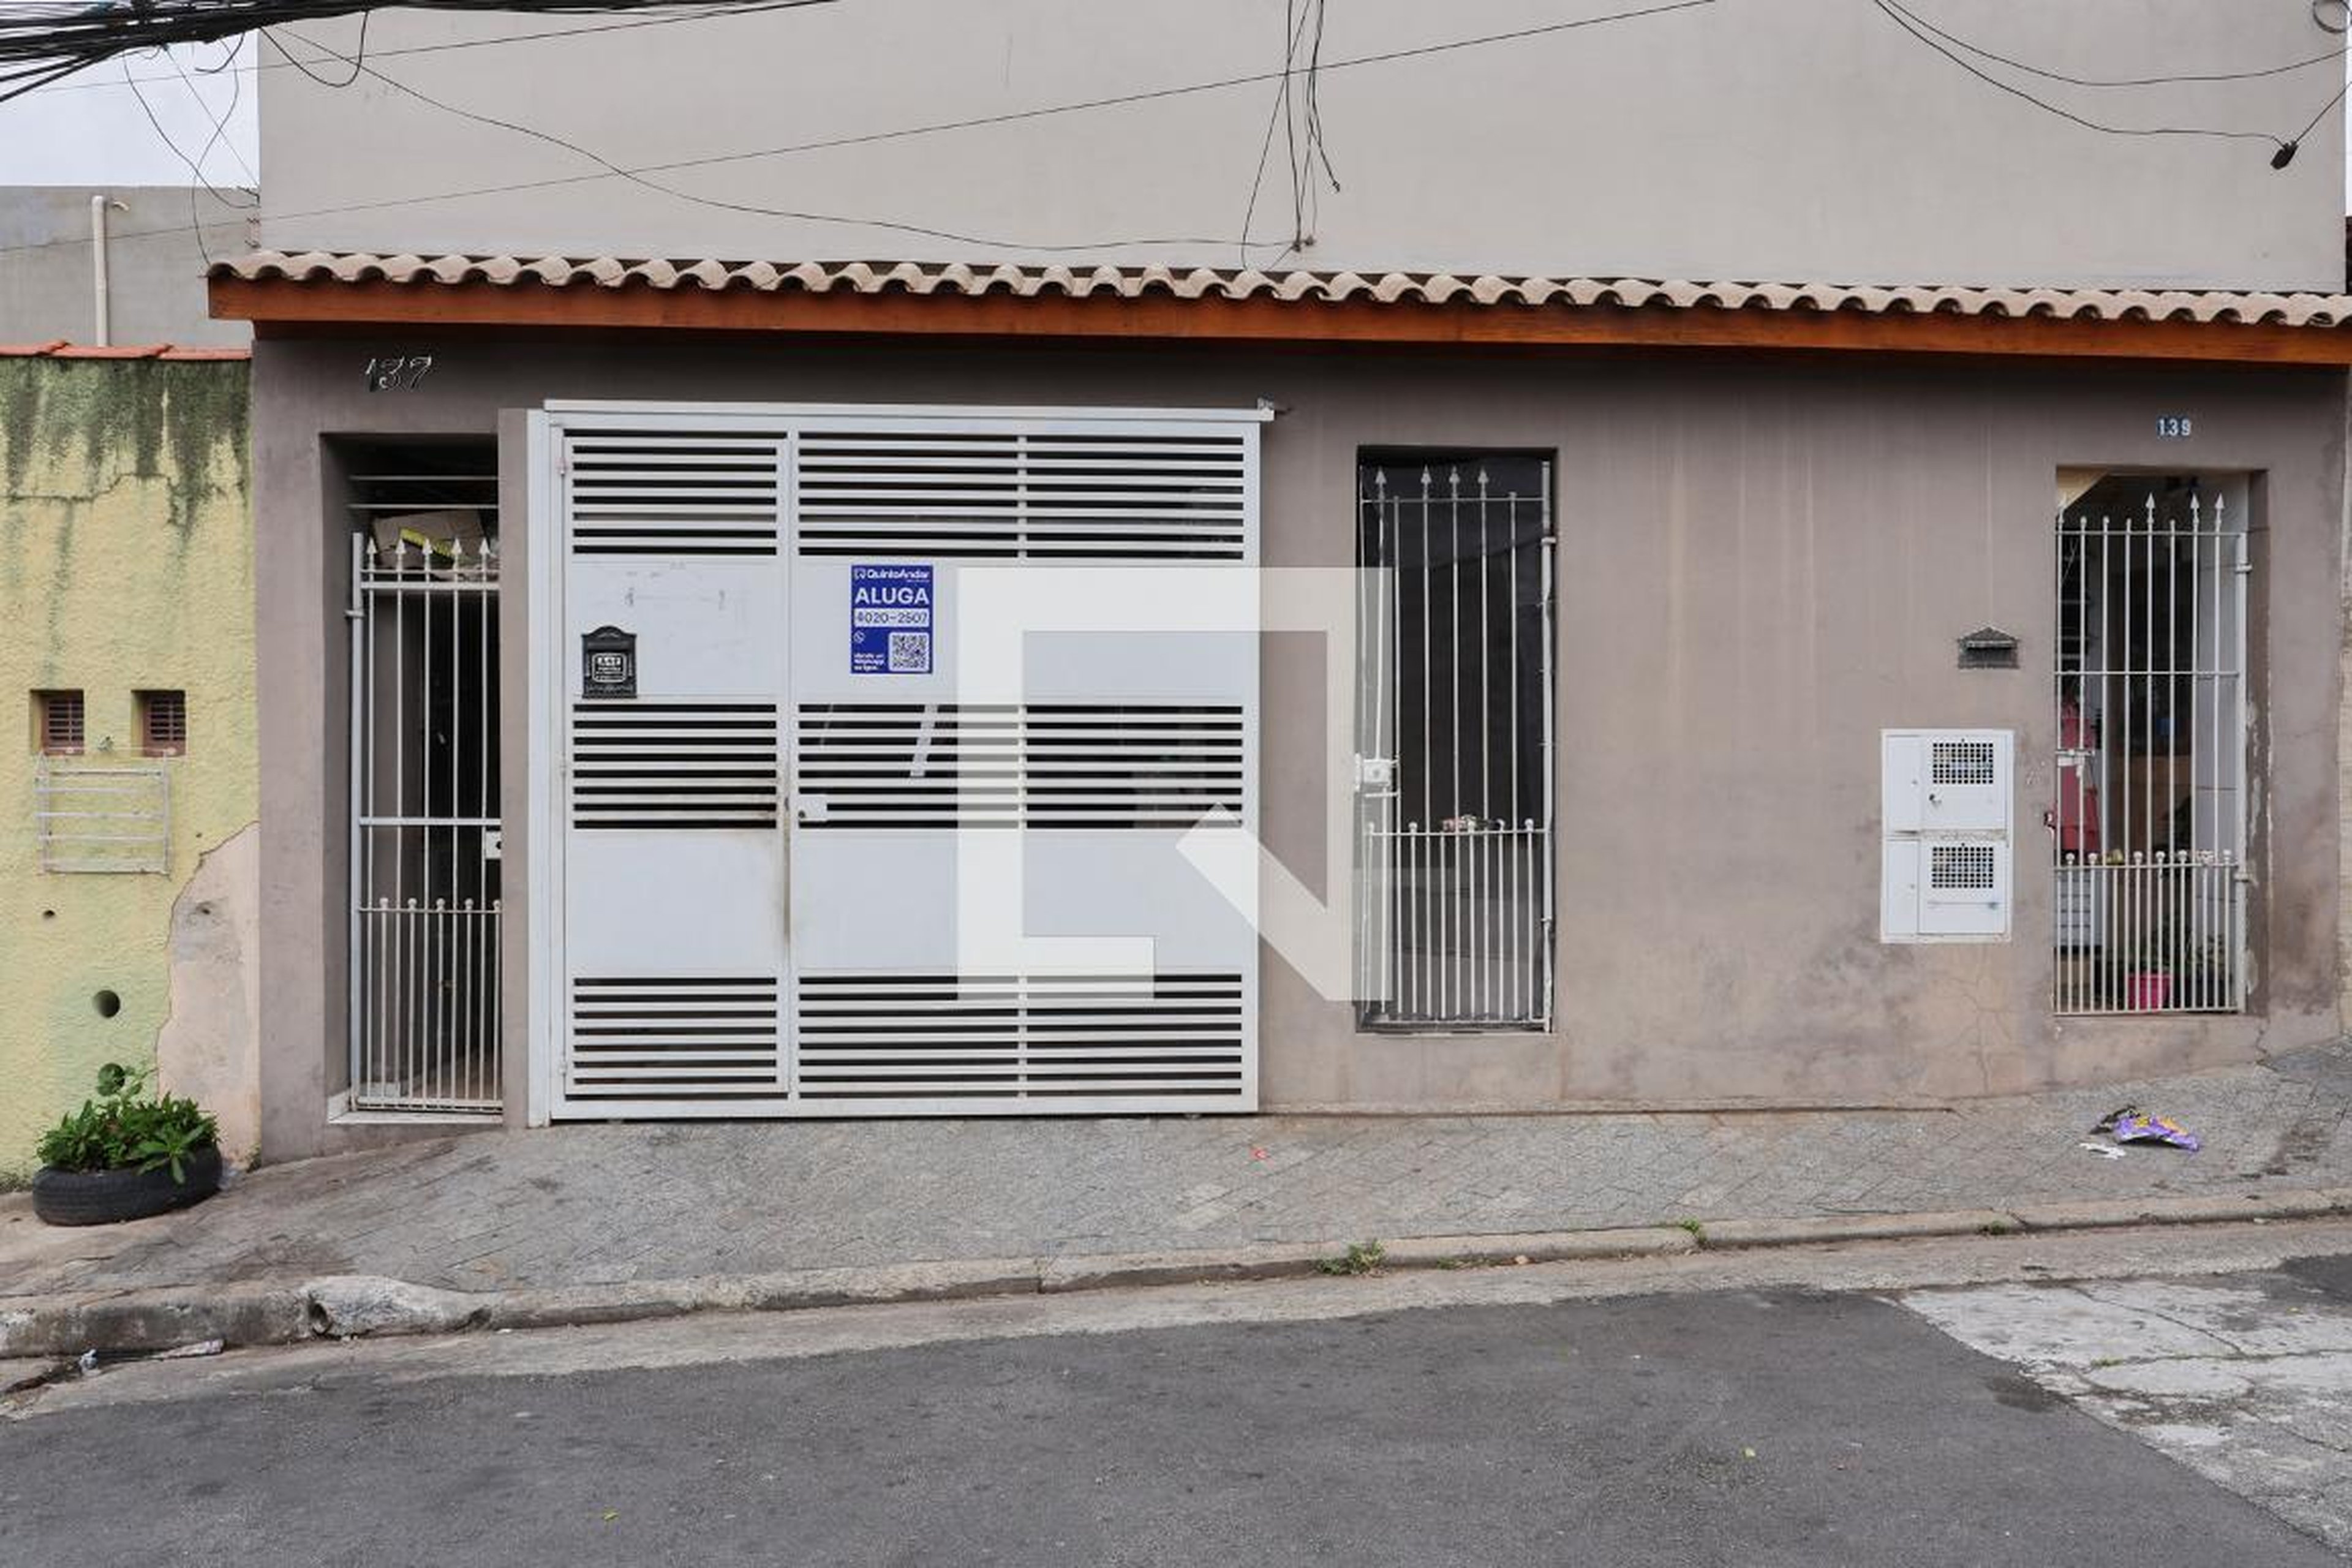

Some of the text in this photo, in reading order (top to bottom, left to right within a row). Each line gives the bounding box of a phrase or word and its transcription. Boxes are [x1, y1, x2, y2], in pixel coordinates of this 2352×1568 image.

[366, 355, 432, 392] 137
[2159, 418, 2191, 436] 139
[855, 587, 929, 605] ALUGA
